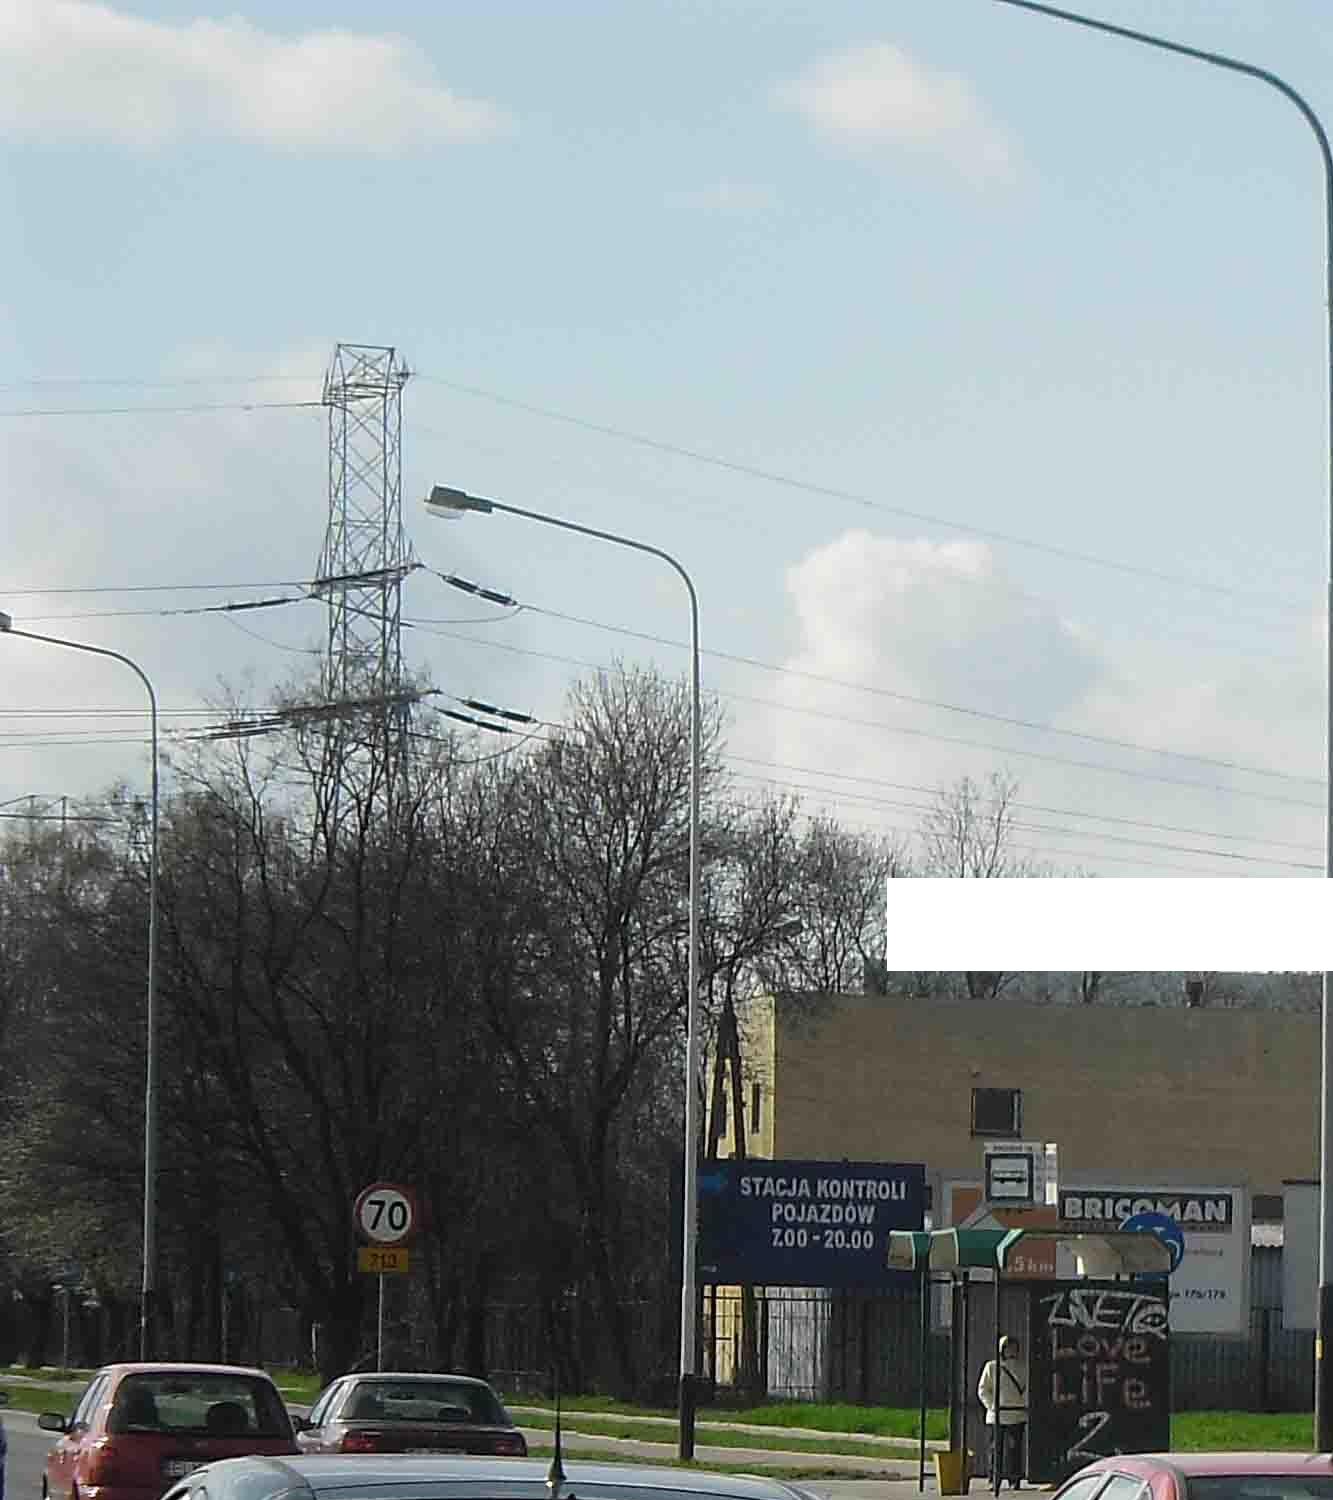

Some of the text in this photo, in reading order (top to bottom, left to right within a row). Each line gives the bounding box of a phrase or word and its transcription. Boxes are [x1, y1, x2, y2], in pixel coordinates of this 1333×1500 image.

[740, 1176, 906, 1200] STACJA KONTROLI
[368, 1200, 409, 1231] 70
[771, 1203, 876, 1225] POJAZDÓW
[1064, 1197, 1227, 1222] BRICOMAN
[823, 1230, 875, 1250] 20.00
